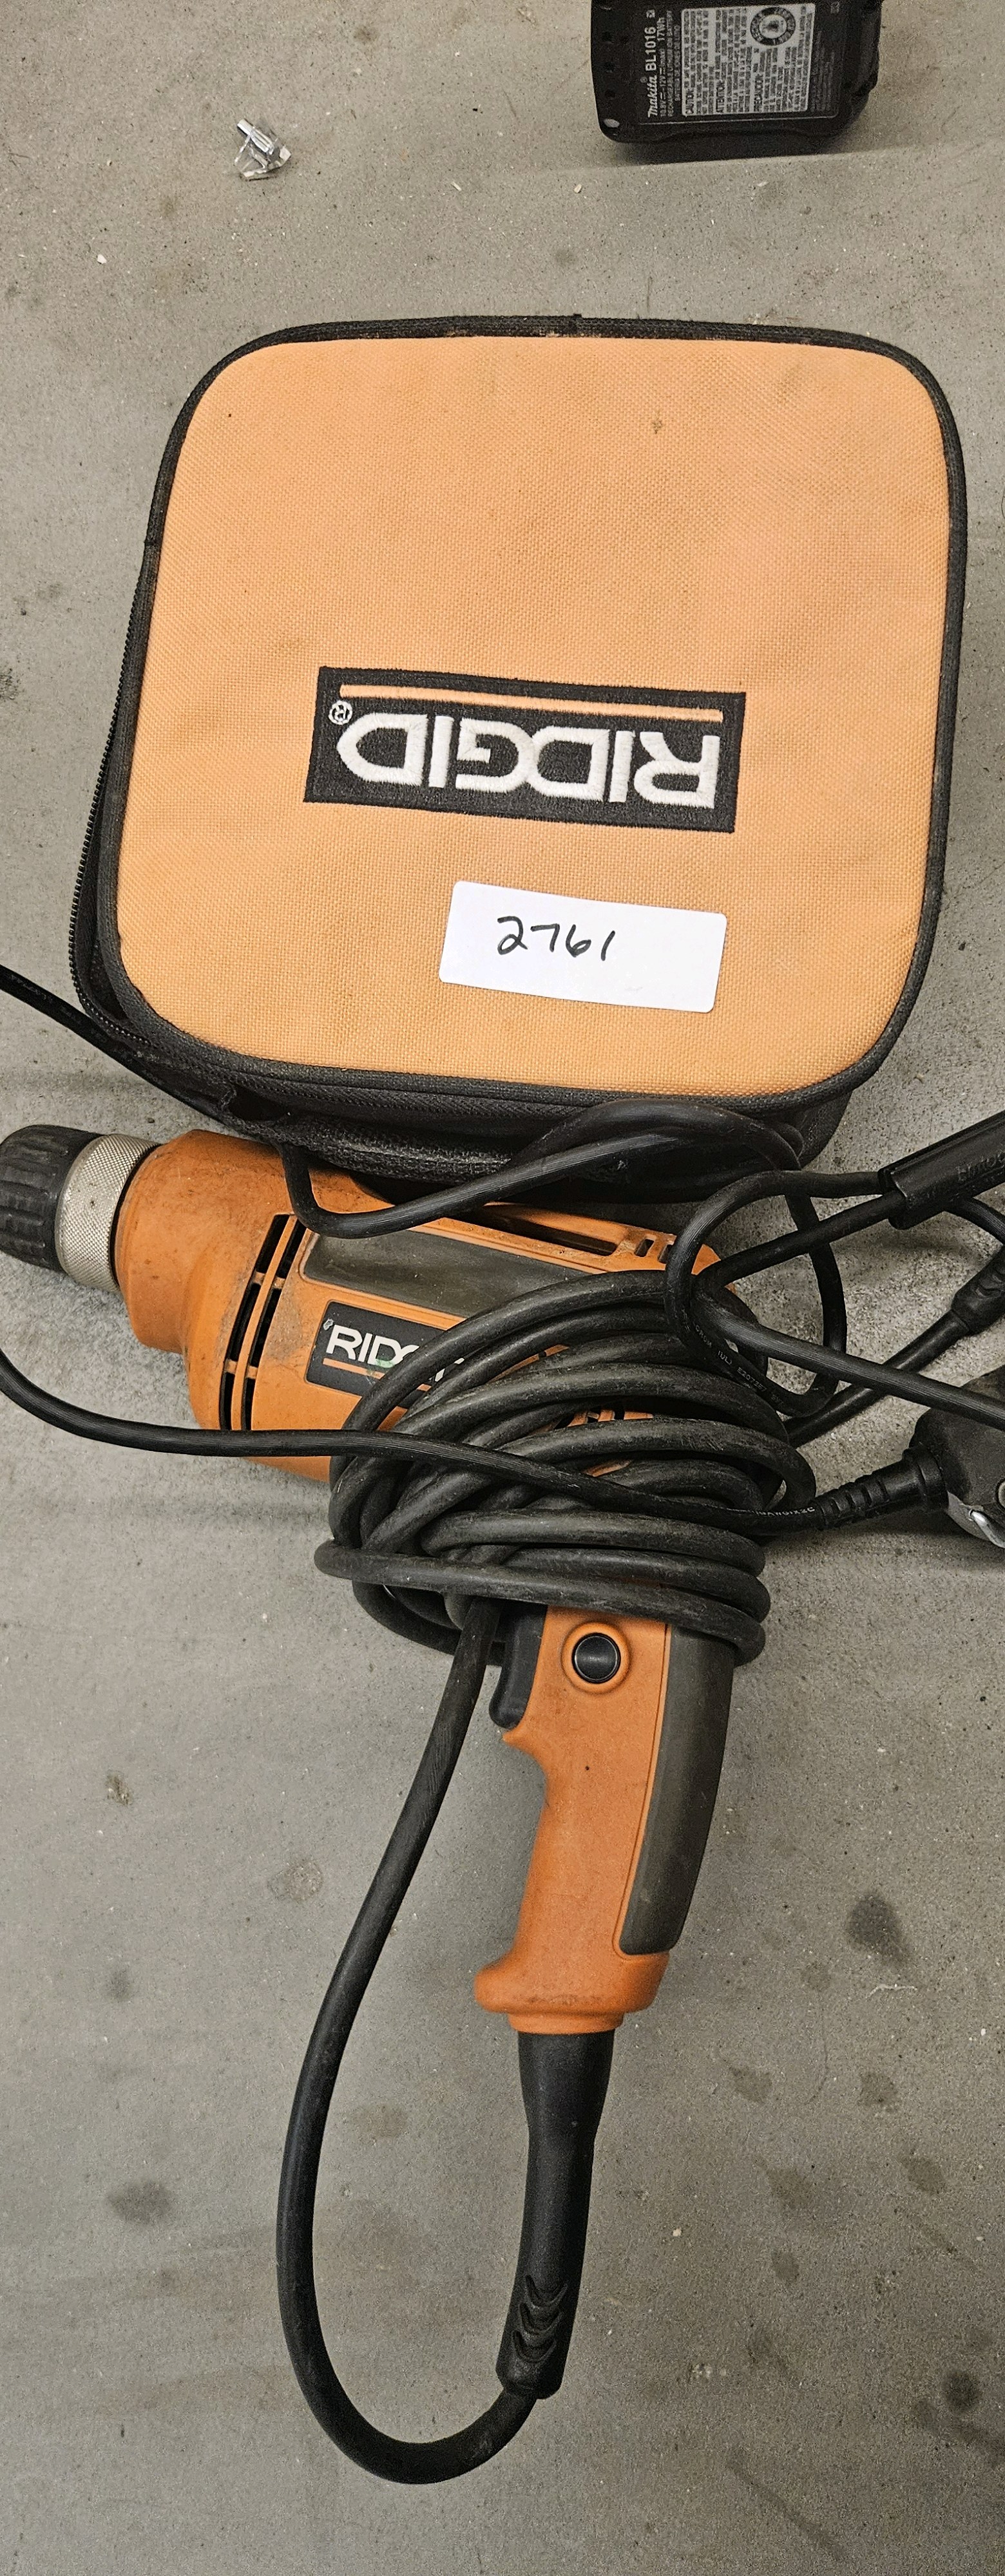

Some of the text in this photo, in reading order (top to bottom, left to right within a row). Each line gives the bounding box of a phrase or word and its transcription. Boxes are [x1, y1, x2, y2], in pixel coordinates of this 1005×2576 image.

[644, 26, 656, 71] BL1016
[656, 17, 665, 42] 17Wh
[336, 713, 721, 809] RIDGID
[497, 915, 616, 961] 2761
